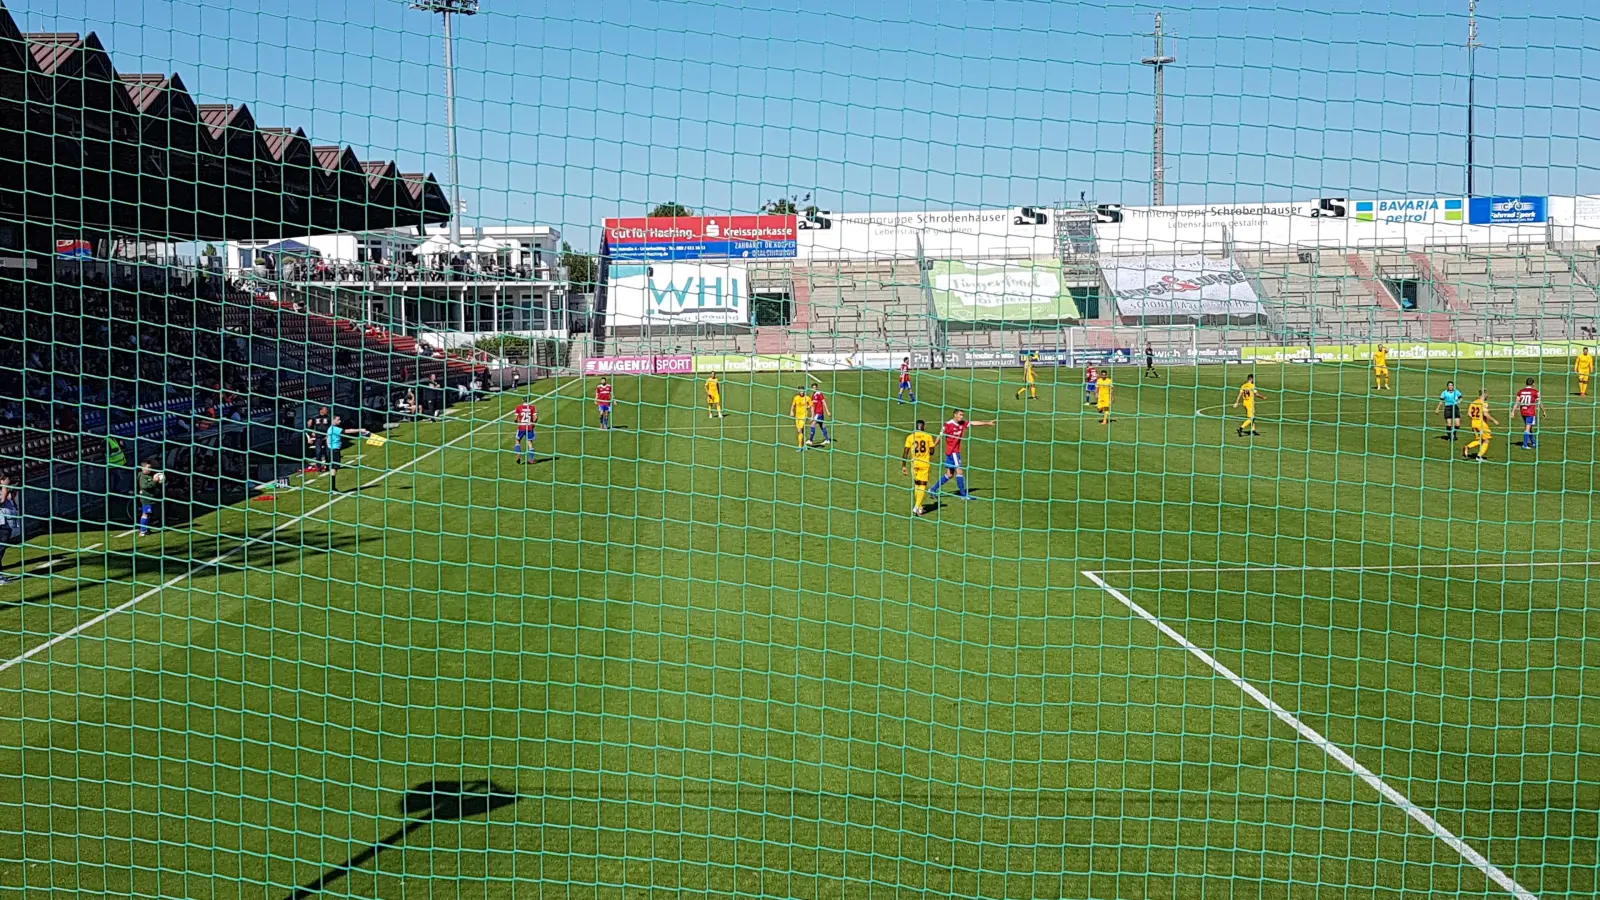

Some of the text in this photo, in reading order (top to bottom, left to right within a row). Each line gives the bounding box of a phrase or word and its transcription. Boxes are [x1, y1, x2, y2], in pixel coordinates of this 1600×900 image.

[1379, 200, 1438, 211] BAVARIA
[1132, 206, 1302, 218] Firmengruppe Schrobenhauser
[842, 212, 1006, 226] Firmengruppe Schrobenhauser
[1228, 218, 1268, 228] gestalten
[1386, 212, 1426, 224] petrol
[612, 228, 630, 238] Gut
[632, 228, 646, 238] für
[724, 227, 792, 237] Kreissparkasse
[934, 226, 972, 236] gestalten
[599, 358, 691, 372] MAGENTA SPORT
[521, 412, 532, 422] 25
[1471, 406, 1480, 418] 22
[914, 440, 926, 453] 28
